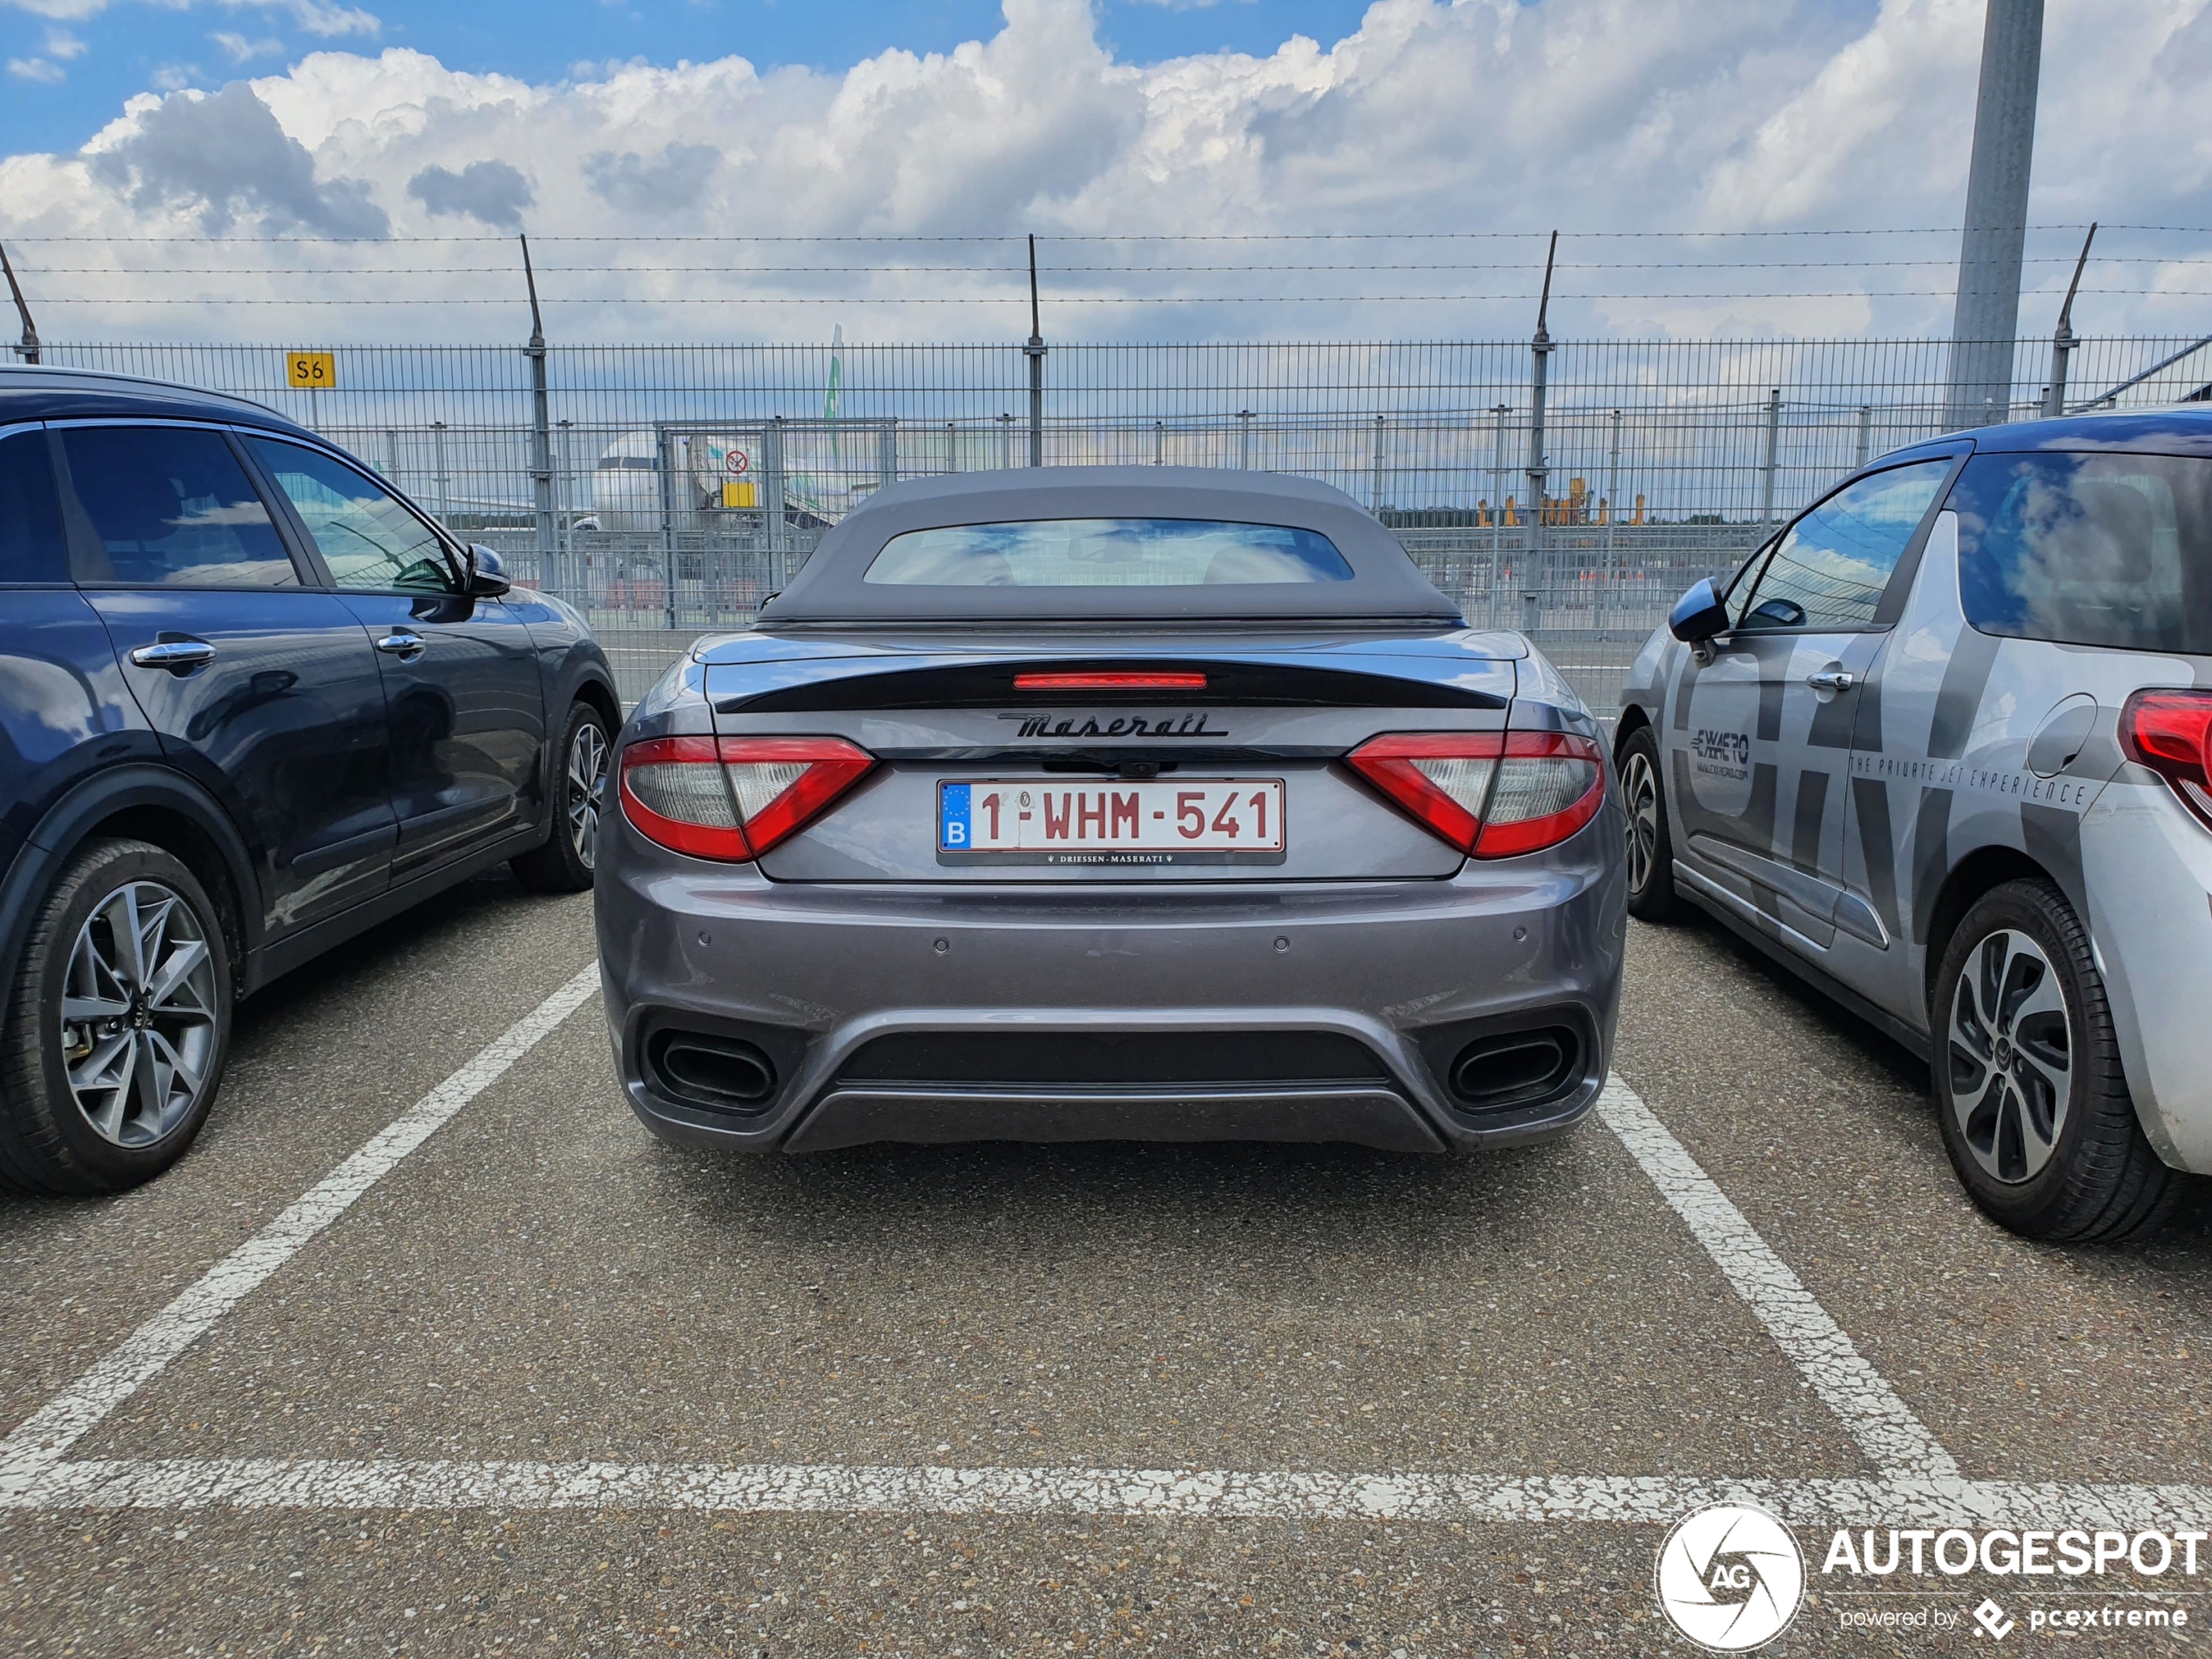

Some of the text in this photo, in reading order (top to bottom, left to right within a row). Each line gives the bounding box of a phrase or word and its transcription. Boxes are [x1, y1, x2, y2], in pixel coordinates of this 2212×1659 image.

[297, 361, 323, 379] S6
[997, 712, 1229, 737] Maserati
[1850, 756, 2087, 806] THE PRIVATE JET EXPERIENCE
[947, 821, 966, 844] B
